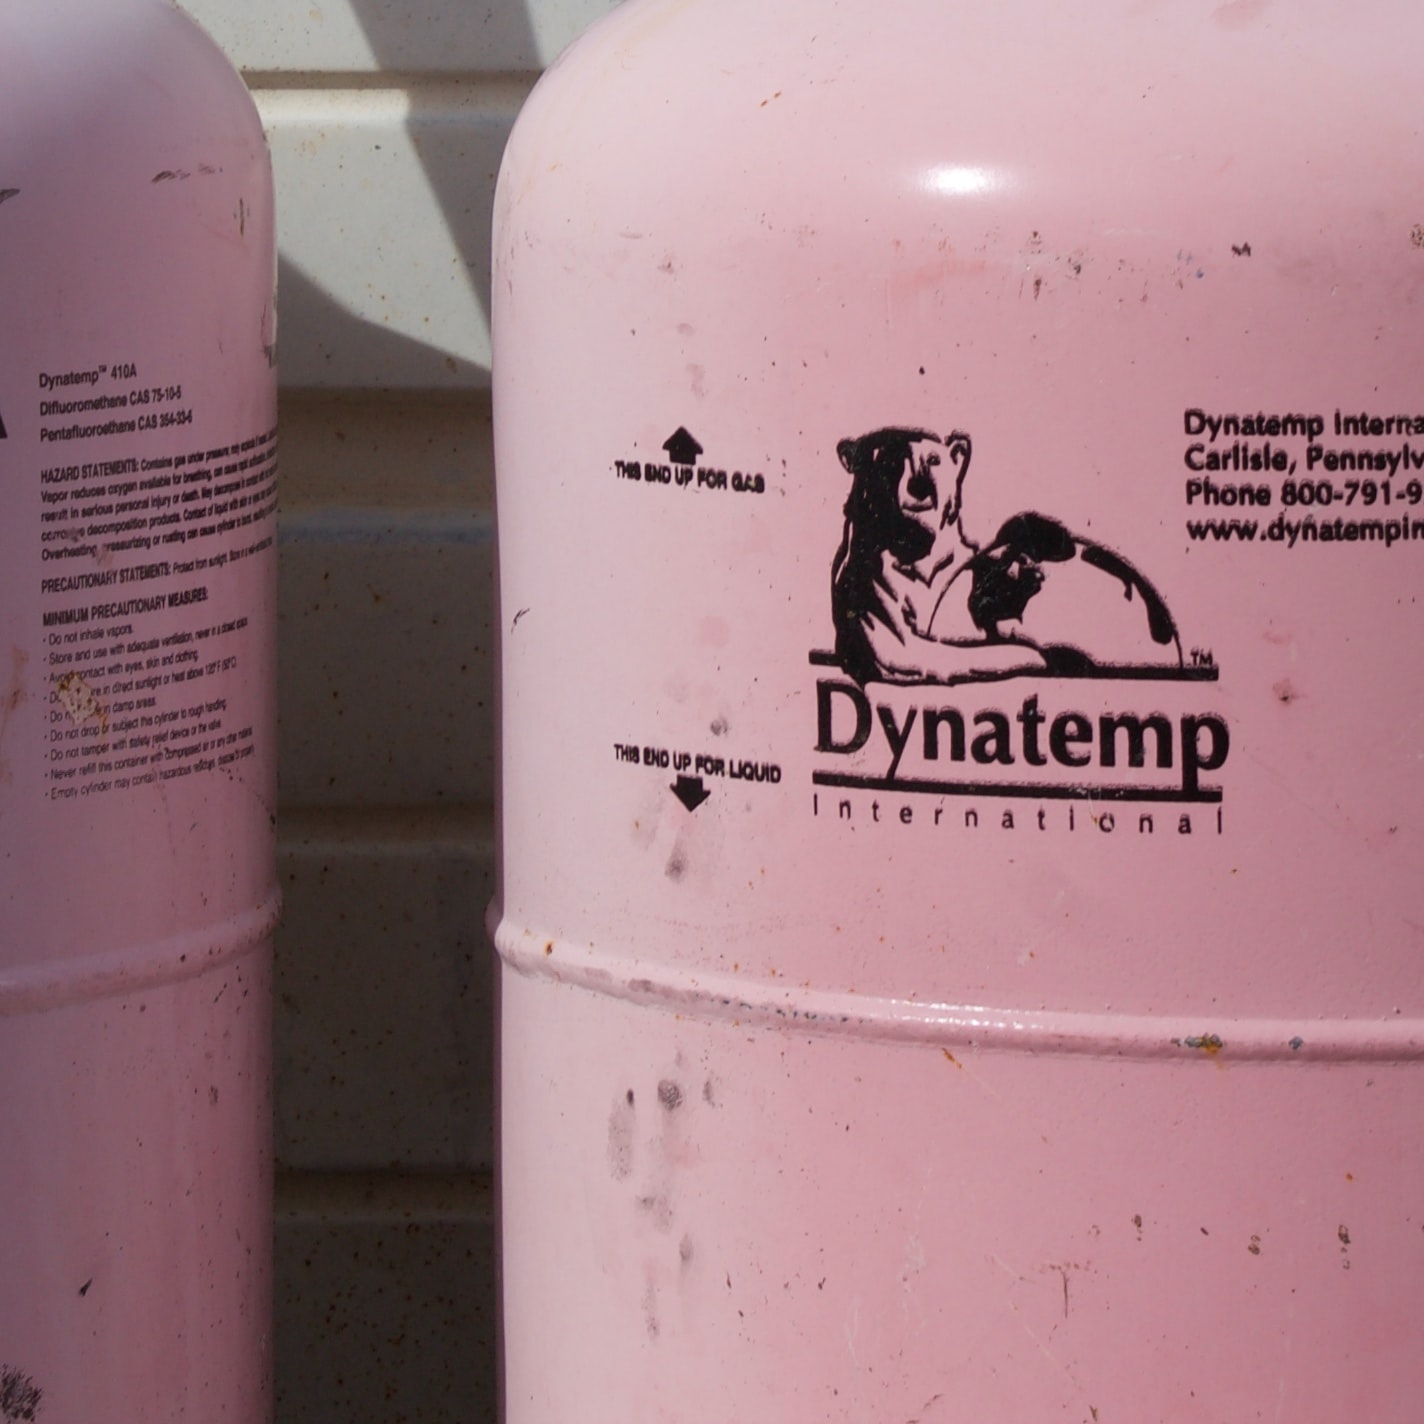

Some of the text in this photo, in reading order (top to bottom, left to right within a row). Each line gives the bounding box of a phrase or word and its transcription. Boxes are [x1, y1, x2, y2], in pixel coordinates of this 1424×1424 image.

[111, 362, 137, 380] 410A
[40, 395, 127, 416] Difluoromethane
[129, 389, 150, 405] CAS
[40, 420, 135, 442] Pentafluoroethane
[138, 413, 158, 430] CAS
[1184, 407, 1324, 442] Dynatemp
[1184, 442, 1297, 475] Carlisle,
[41, 466, 79, 484] HAZARD
[81, 459, 139, 479] STATEMENTS:
[675, 467, 693, 487] UP
[697, 467, 727, 490] FOR
[41, 488, 68, 504] Vapor
[71, 486, 105, 499] reduces
[108, 480, 137, 496] oxygen
[1185, 476, 1272, 506] Phone
[71, 506, 78, 519] in
[82, 503, 113, 517] serious
[115, 498, 149, 515] personal
[87, 518, 147, 536] decomposition
[41, 570, 118, 594] PRECAUTIONARY
[120, 562, 171, 584] STATEMENTS:
[43, 608, 89, 627] MINIMUM
[91, 595, 166, 620] PRECAUTIONARY
[48, 633, 62, 646] Do
[64, 632, 78, 644] not
[80, 626, 104, 641] inhale
[49, 652, 72, 665] Store
[75, 649, 90, 661] and
[93, 647, 107, 659] use
[110, 643, 125, 656] with
[112, 681, 134, 693] direct
[50, 710, 63, 723] Do
[112, 701, 134, 713] damp
[50, 729, 63, 742] Do
[65, 728, 79, 739] not
[81, 725, 100, 738] drop
[112, 718, 138, 733] subject
[813, 678, 1229, 792] Dynatemp
[50, 748, 63, 761] Do
[65, 748, 79, 759] not
[81, 743, 109, 757] tamper
[614, 742, 639, 763] THIS
[673, 750, 691, 771] UP
[695, 753, 725, 777] FOR
[729, 758, 781, 783] LIQUID
[51, 768, 77, 780] Never
[99, 760, 113, 772] this
[114, 755, 148, 769] container
[51, 787, 78, 800] Empty
[81, 781, 112, 796] cylinder
[813, 793, 1223, 835] International
